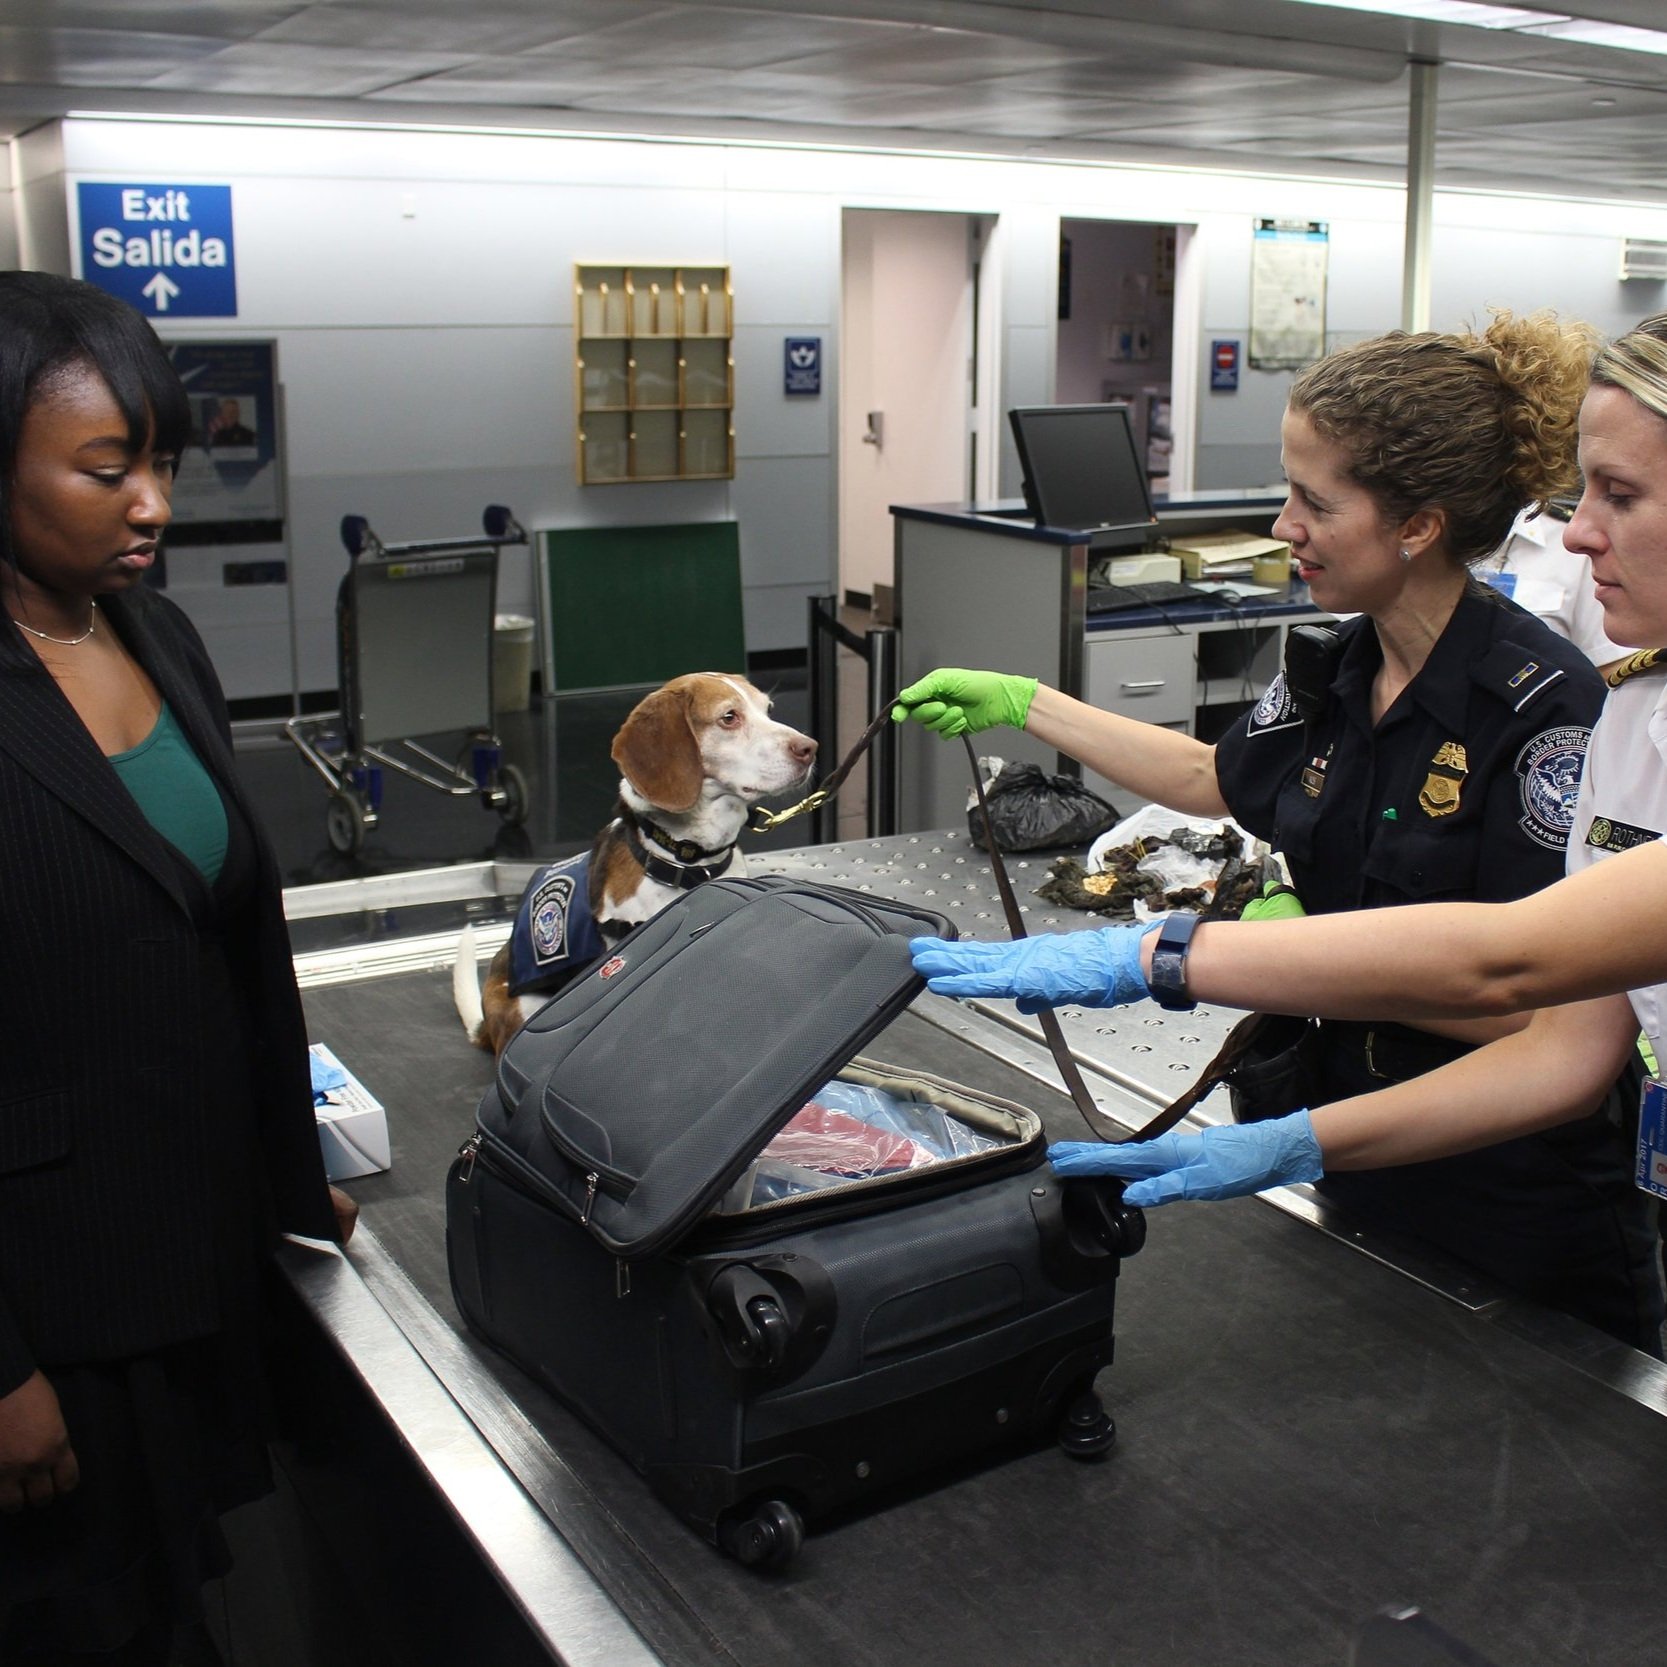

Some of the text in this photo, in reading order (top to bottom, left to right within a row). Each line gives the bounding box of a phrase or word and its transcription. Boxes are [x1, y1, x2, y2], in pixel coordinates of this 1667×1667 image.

[122, 189, 190, 221] Exit
[93, 228, 226, 267] Salida
[1527, 738, 1588, 765] BORDER PROTEC
[1530, 740, 1544, 752] U.S.
[1545, 731, 1583, 743] CUSTOMS
[1543, 832, 1565, 843] FIELD
[1639, 1138, 1648, 1160] 2017
